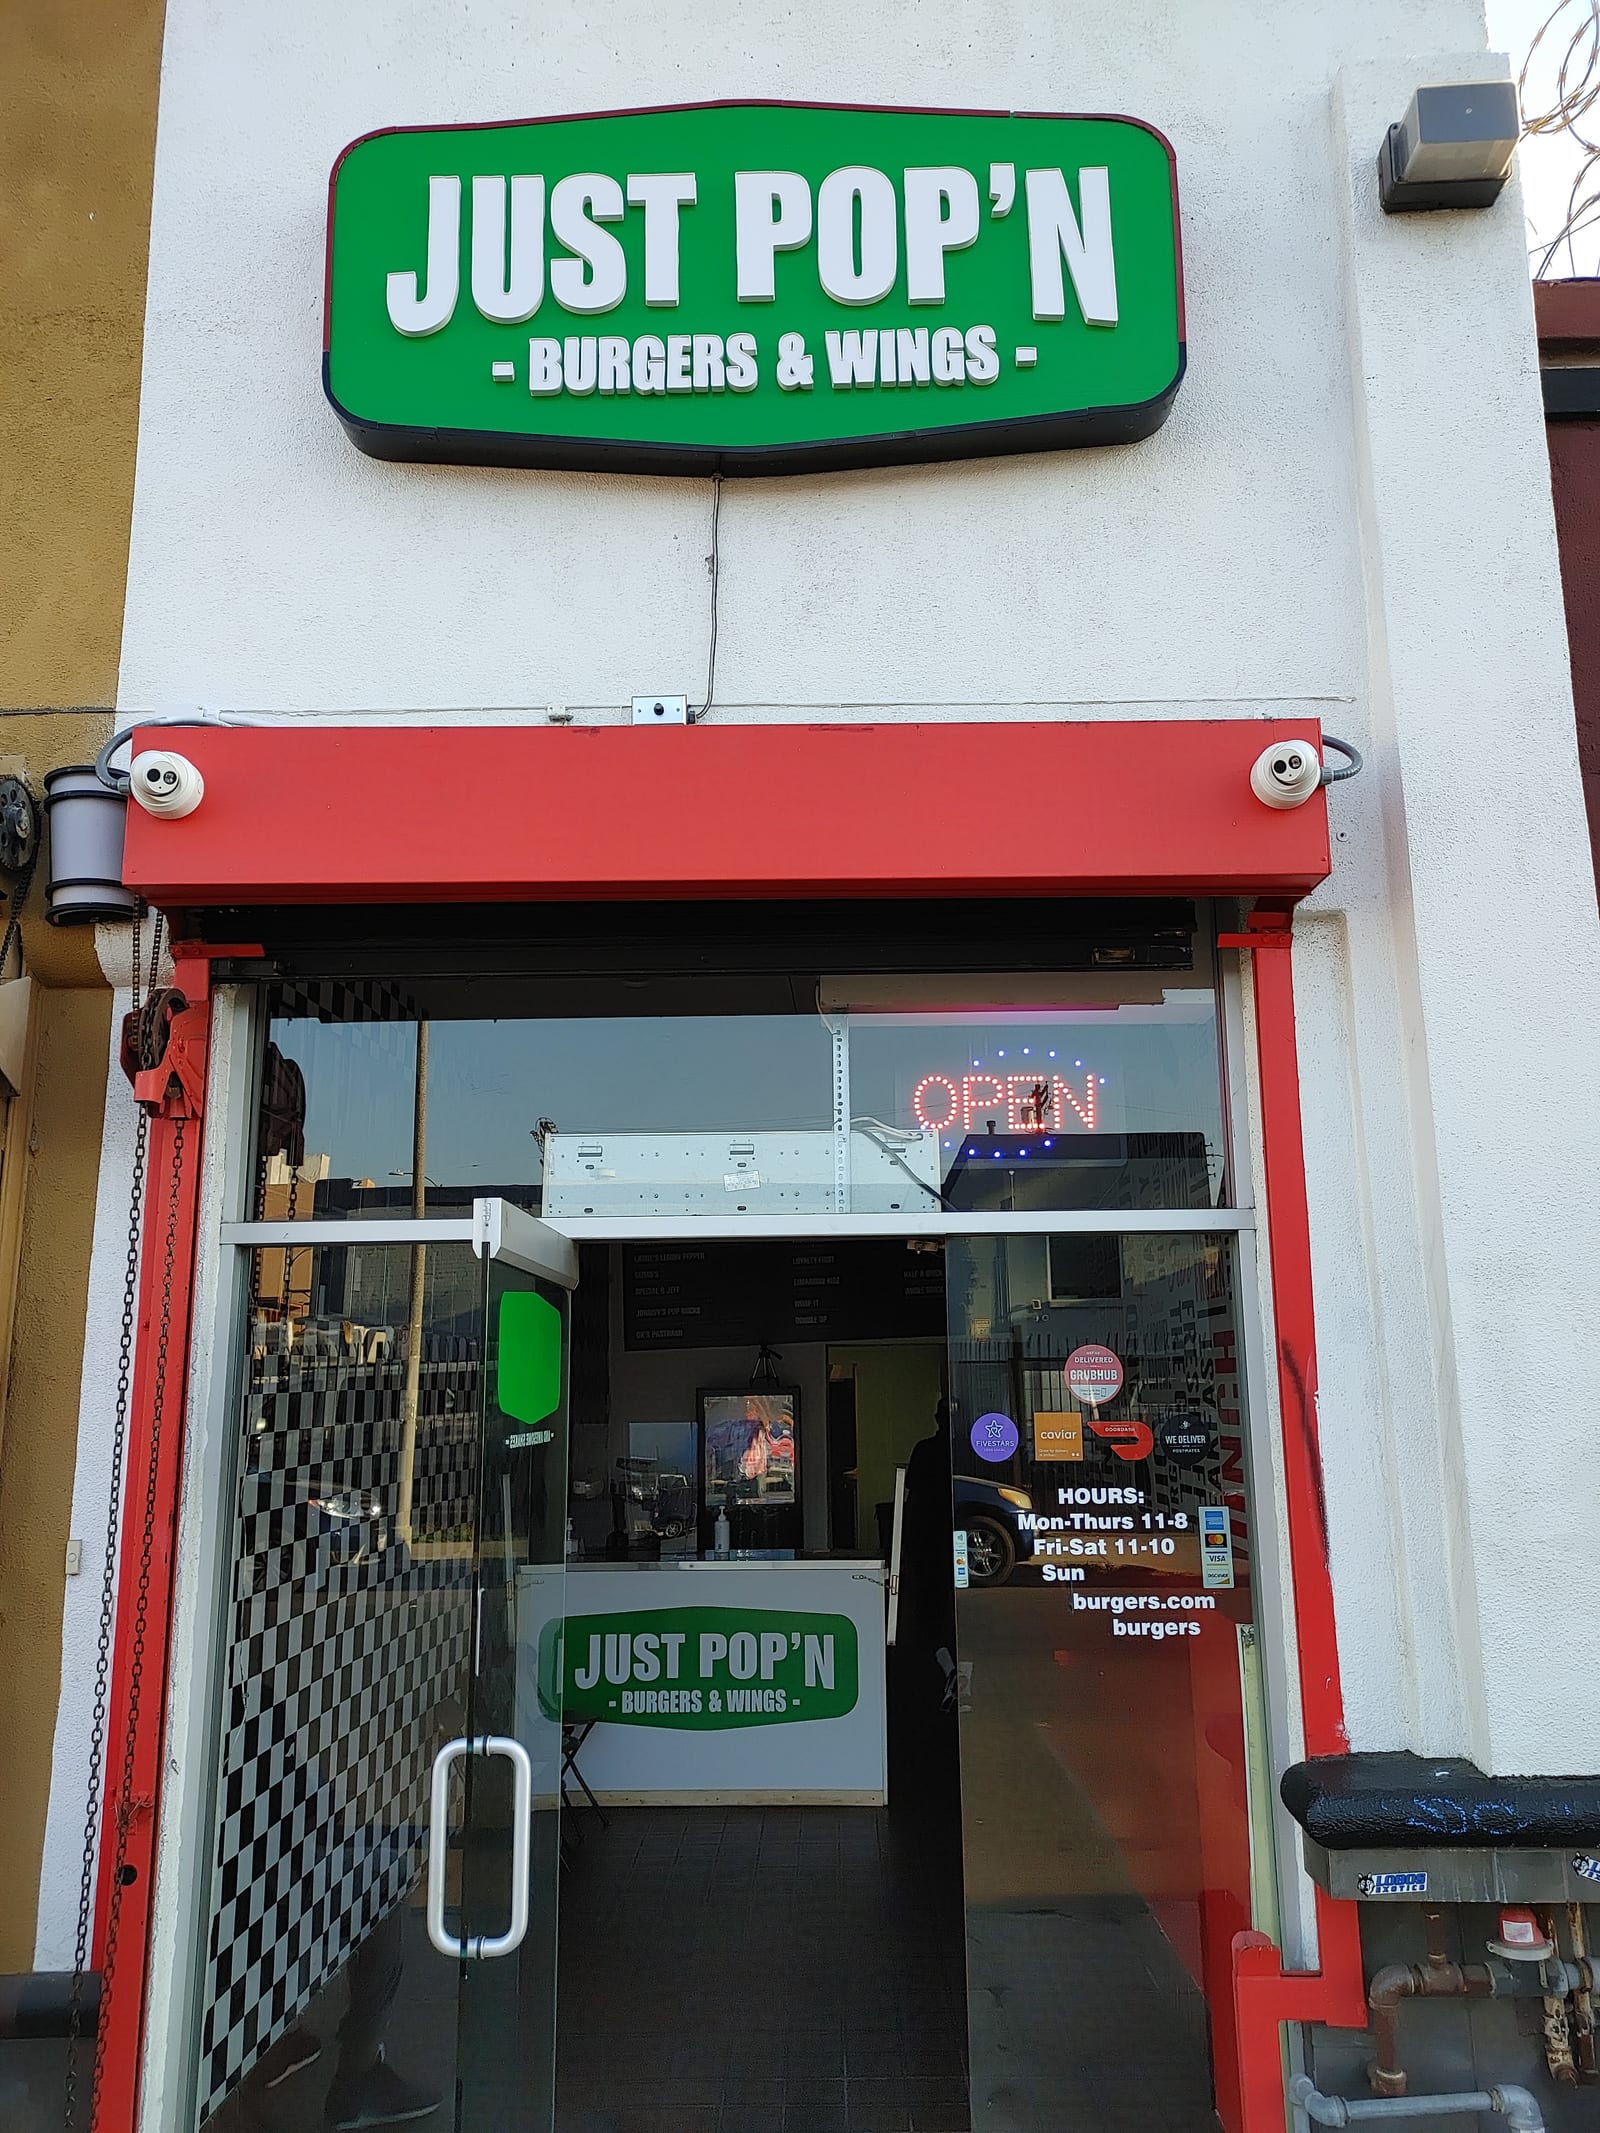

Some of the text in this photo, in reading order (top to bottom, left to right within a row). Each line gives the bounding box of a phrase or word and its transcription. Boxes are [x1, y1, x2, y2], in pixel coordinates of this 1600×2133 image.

[386, 162, 1119, 338] JUST POP'N
[528, 332, 759, 397] BURGERS
[776, 331, 814, 391] &
[824, 324, 1000, 389] WINGS
[913, 1074, 1097, 1131] OPEN
[1074, 1356, 1114, 1364] DELIVERED
[1070, 1369, 1118, 1381] GRUBHUB
[1040, 1429, 1077, 1440] caviar
[1165, 1434, 1206, 1445] WE DELIVER
[1058, 1487, 1145, 1505] HOURS:
[1017, 1513, 1134, 1531] Mon-Thurs
[1141, 1512, 1188, 1530] 11-8
[1033, 1537, 1175, 1556] Fri-Sat 11-10
[1209, 1555, 1226, 1563] VISA
[1042, 1564, 1085, 1582] Sun
[1073, 1592, 1216, 1614] burgers.com
[1113, 1618, 1201, 1640] burgers
[574, 1631, 836, 1691] JUST POP'N
[621, 1690, 702, 1714] BURGERS
[708, 1689, 722, 1713] &
[726, 1688, 787, 1713] WINGS
[1376, 1873, 1426, 1886] LOBOS
